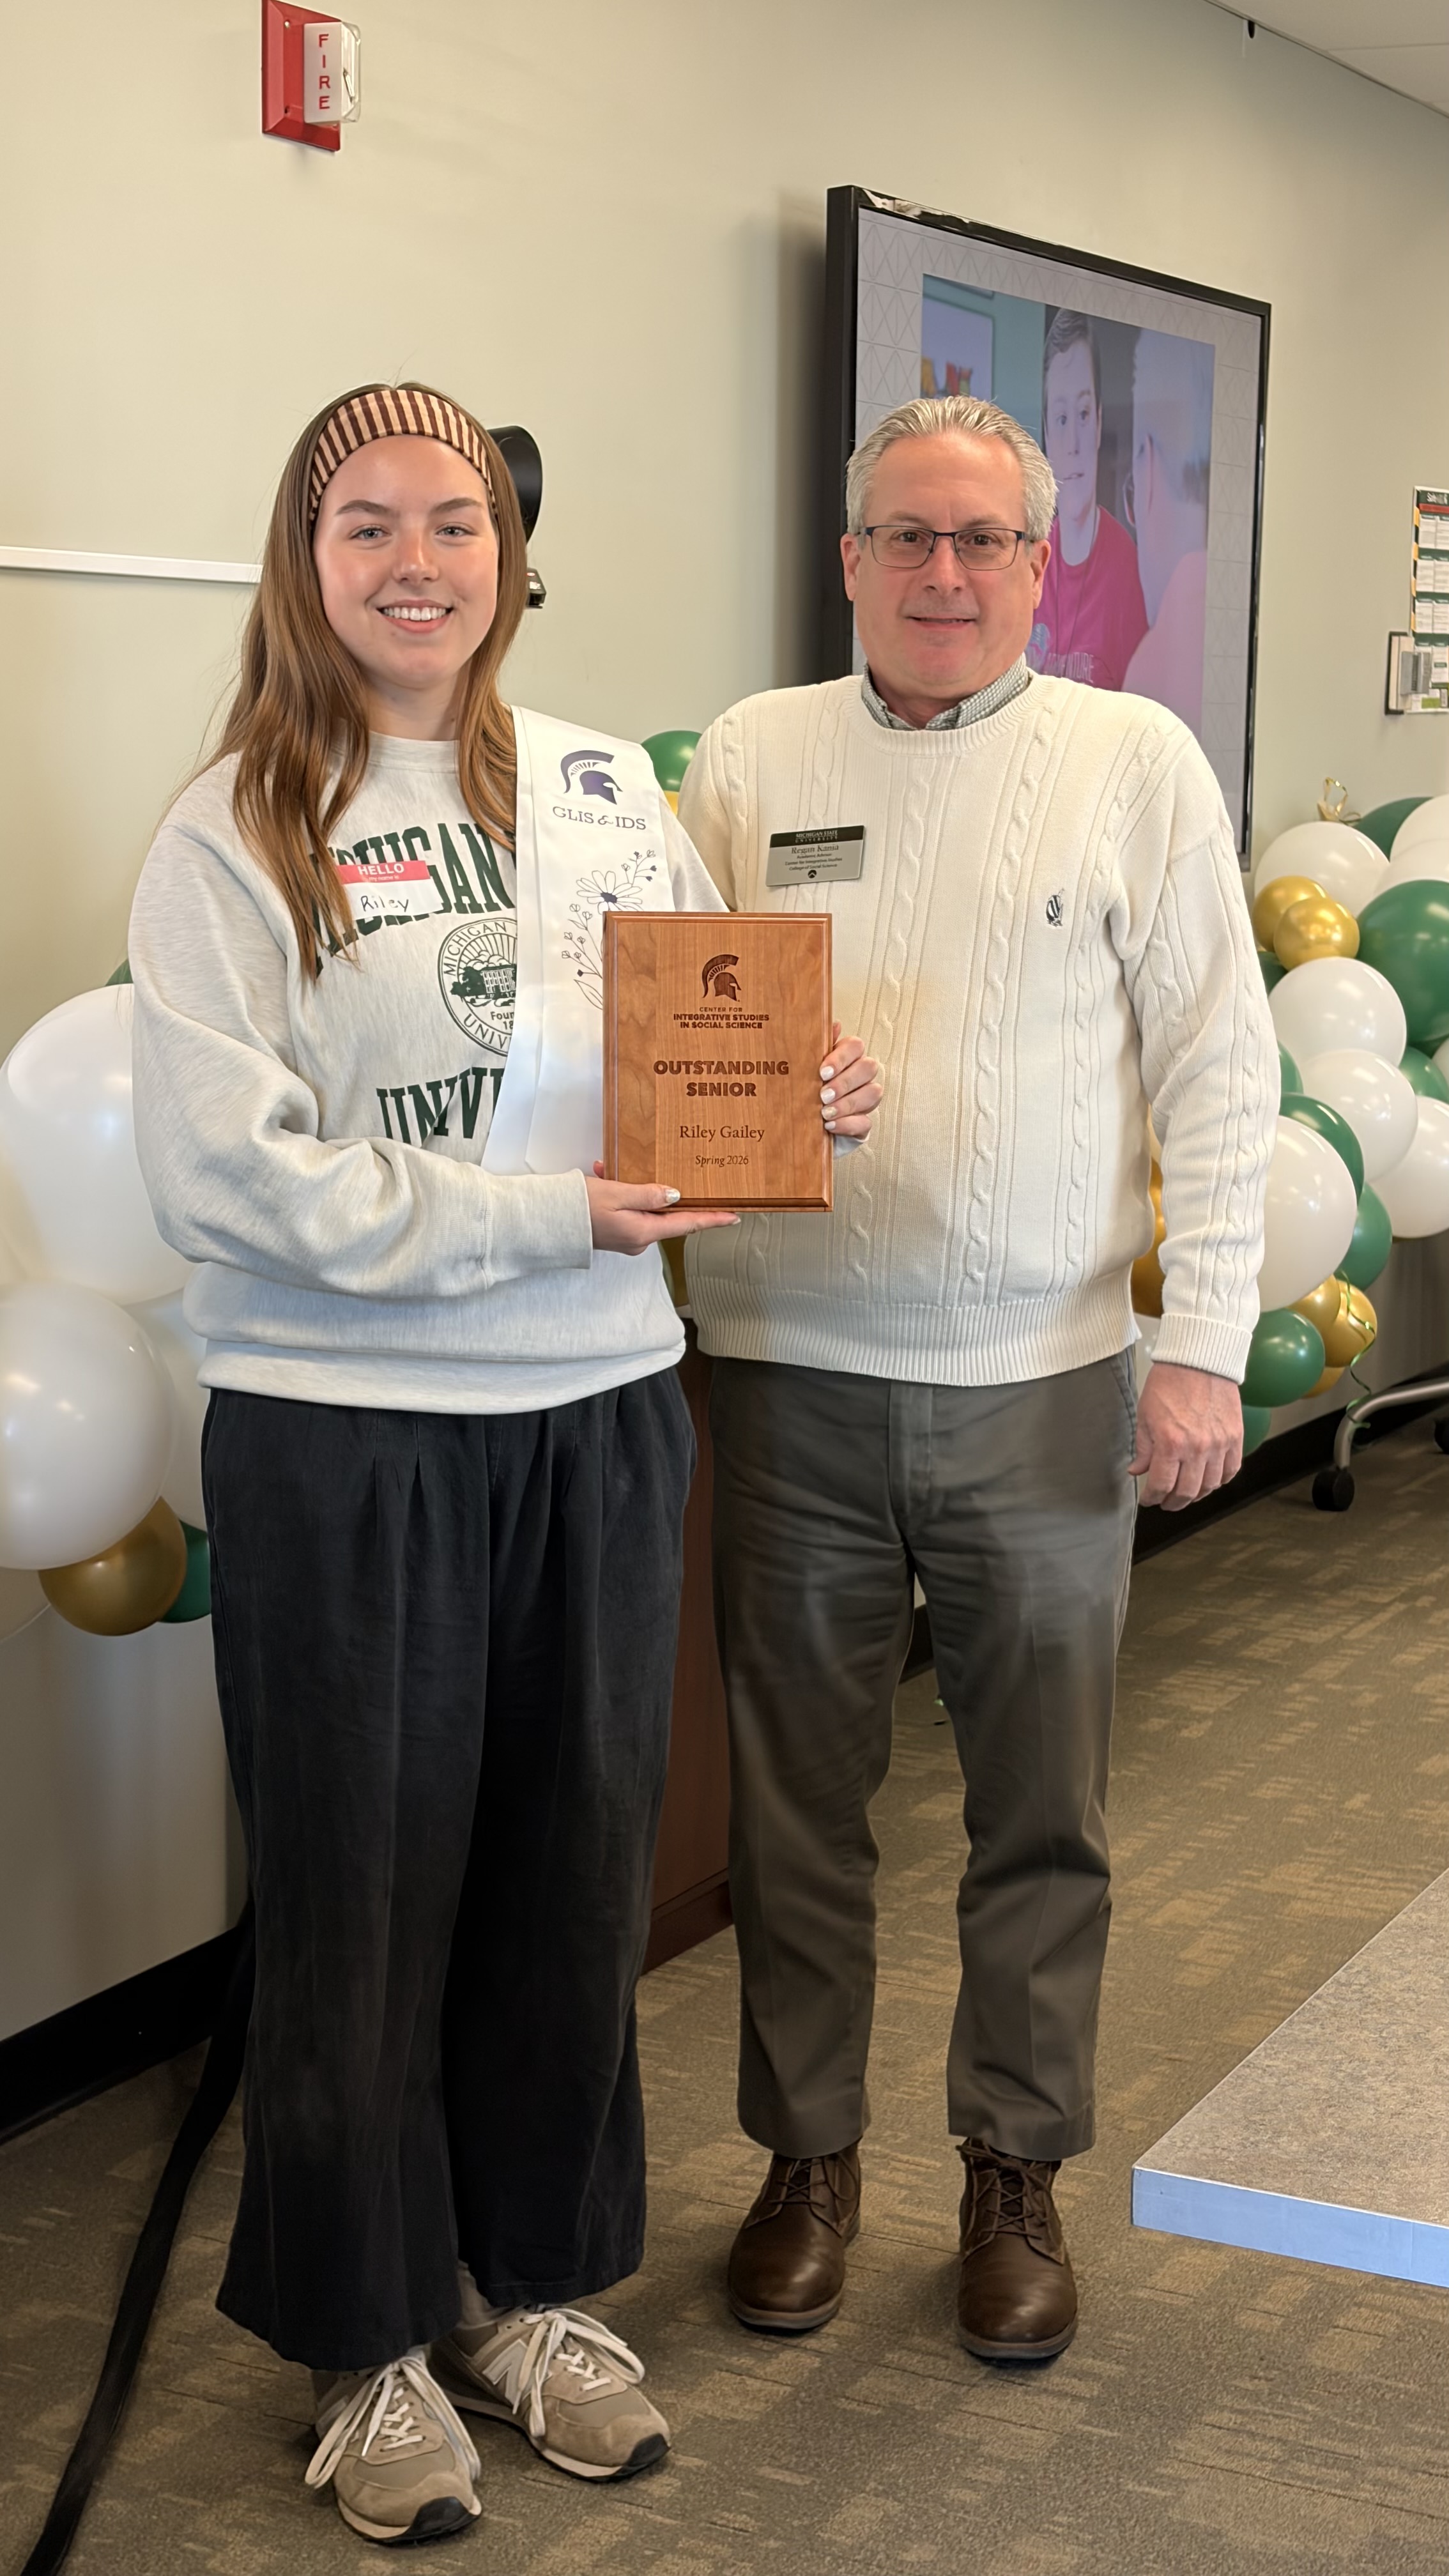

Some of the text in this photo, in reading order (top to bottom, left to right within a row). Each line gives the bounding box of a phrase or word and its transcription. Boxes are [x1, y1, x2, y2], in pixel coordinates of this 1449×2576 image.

[319, 34, 330, 109] FIRE
[552, 806, 647, 831] GLIS & IDS
[357, 862, 405, 875] HELLO
[360, 895, 409, 912] Riley
[443, 921, 507, 976] MICHIGAN
[463, 1013, 512, 1050] UNIV
[653, 1060, 789, 1075] OUTSTANDING
[686, 1082, 757, 1097] SENIOR
[680, 1124, 765, 1142] Riley Gailey
[695, 1155, 749, 1168] Spring 2026
